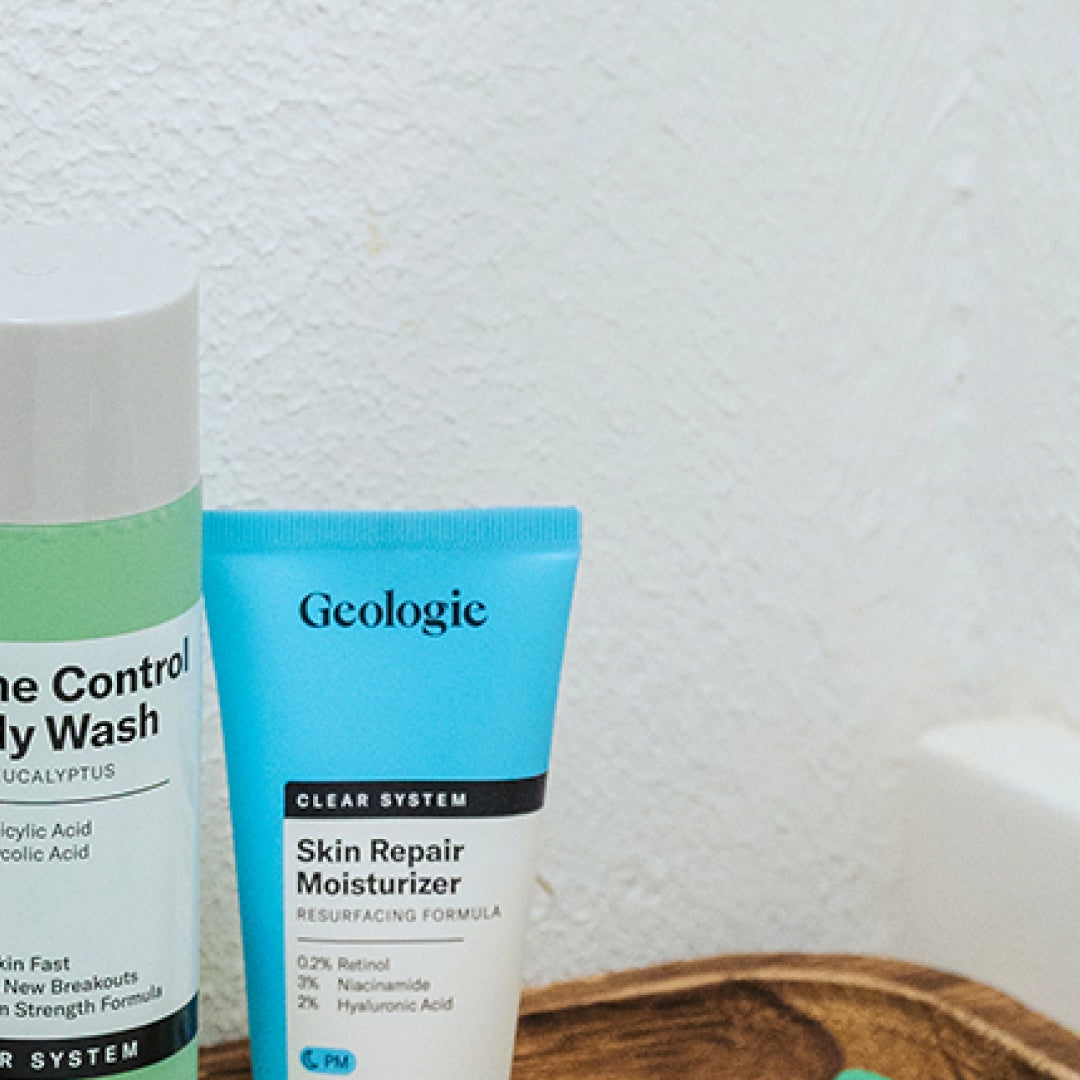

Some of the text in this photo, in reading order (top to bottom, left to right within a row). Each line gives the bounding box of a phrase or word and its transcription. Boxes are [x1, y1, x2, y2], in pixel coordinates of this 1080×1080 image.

[299, 588, 489, 638] Geologie
[52, 635, 189, 702] Control
[44, 702, 159, 752] Wash
[296, 792, 468, 809] CLEAR SYSTEM
[51, 819, 93, 839] Acid
[48, 843, 90, 862] Acid
[296, 837, 465, 868] Skin Repair
[297, 870, 463, 896] Moisturizer
[297, 904, 503, 923] RESURFACING FORMULA
[30, 955, 71, 973] Fast
[297, 955, 392, 973] 0.2% Retinol
[3, 978, 45, 996] New
[51, 970, 139, 996] Breakouts
[297, 975, 432, 993] 3% Niacinamide
[14, 997, 95, 1021] Strength
[101, 984, 163, 1014] Formula
[297, 995, 455, 1016] 2% Hyaluronic Acid
[30, 1040, 139, 1070] SYSTEM
[324, 1054, 350, 1070] PM
